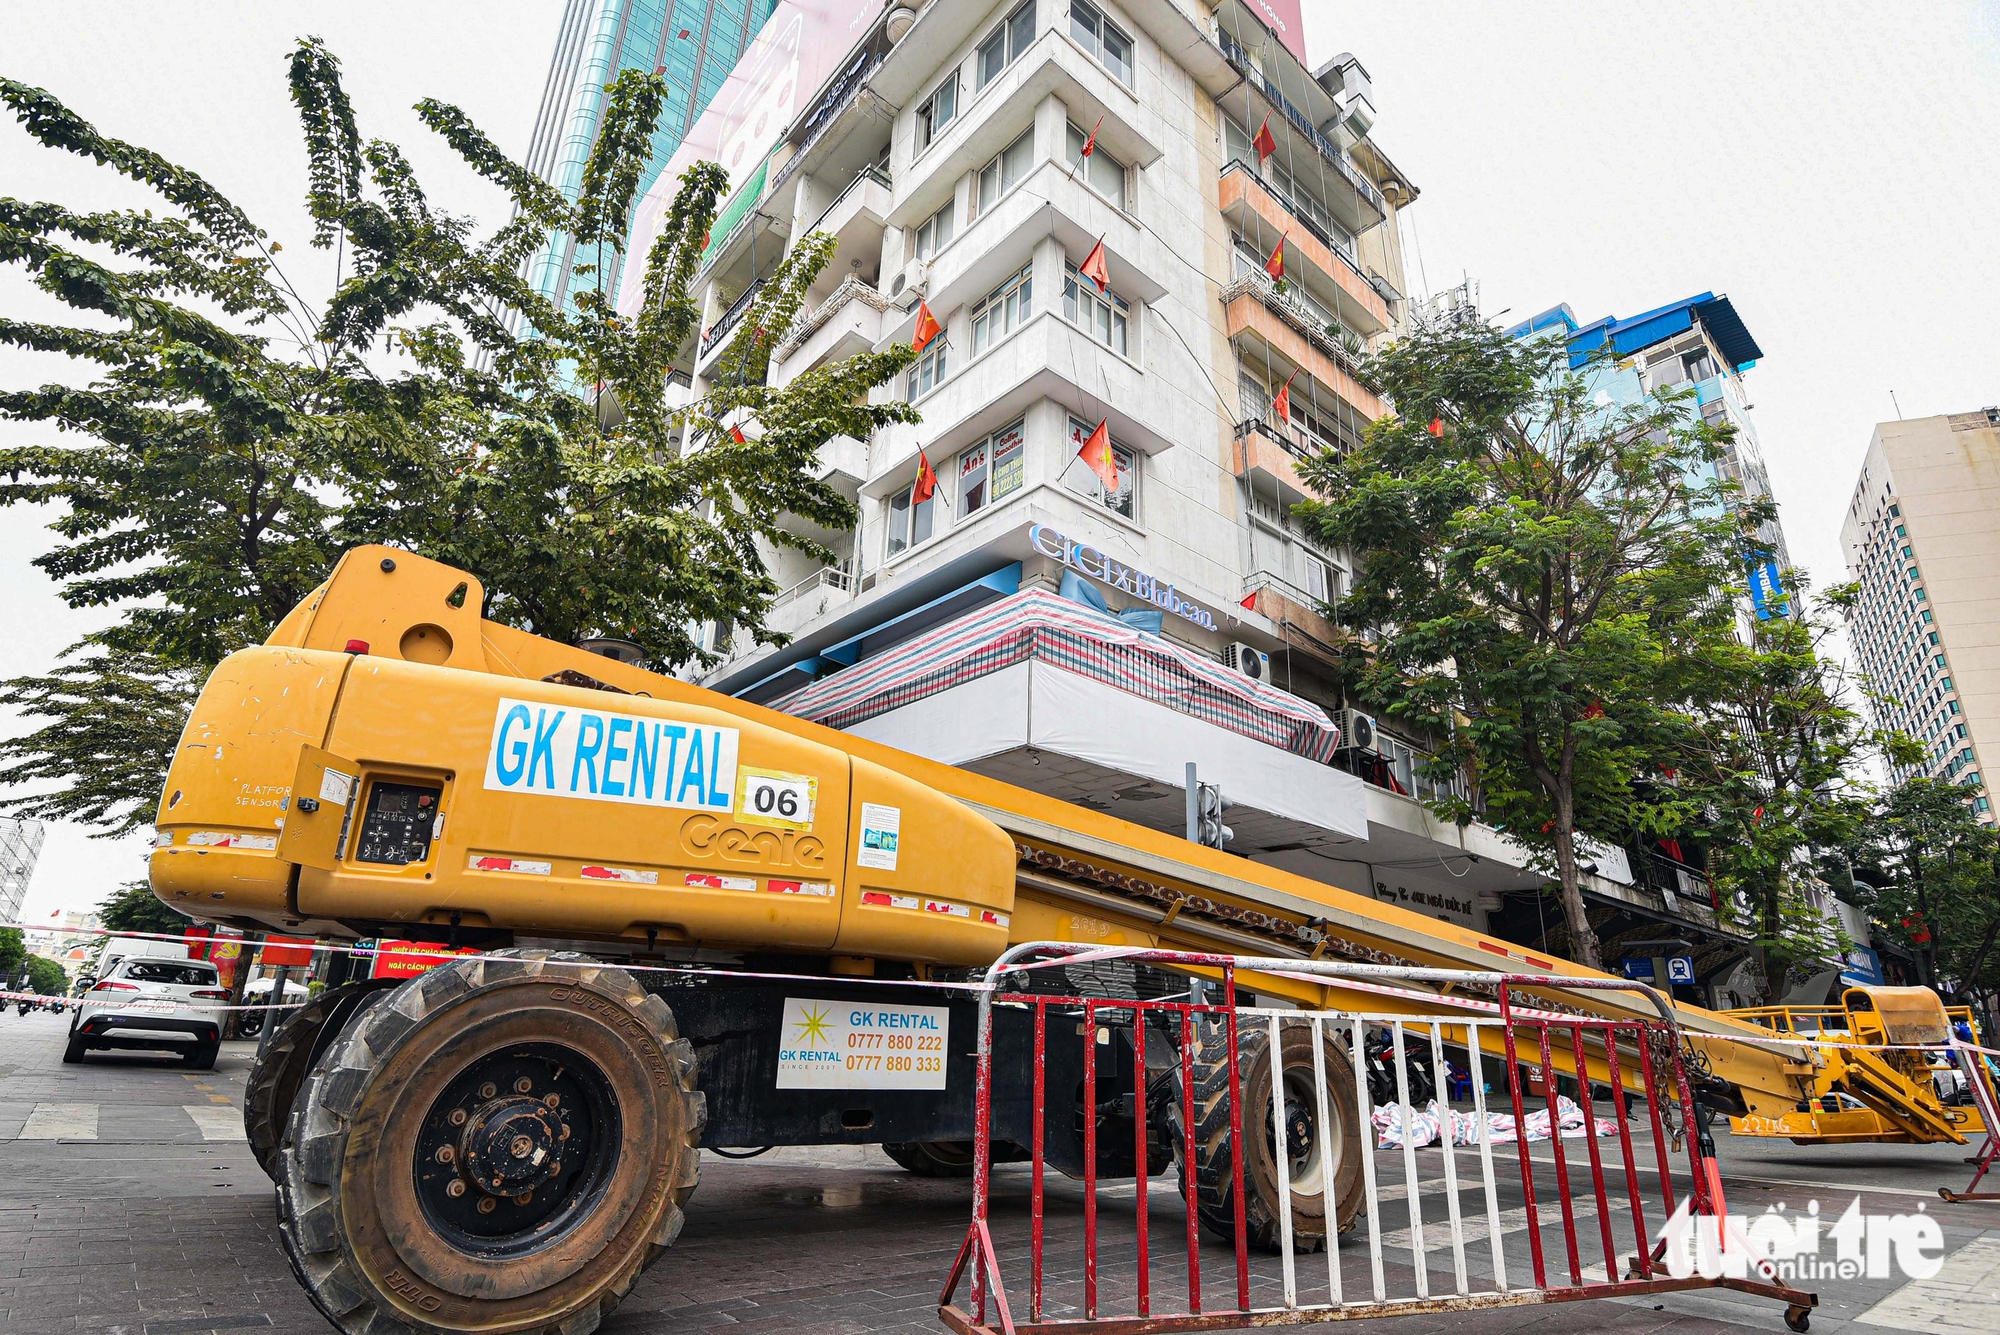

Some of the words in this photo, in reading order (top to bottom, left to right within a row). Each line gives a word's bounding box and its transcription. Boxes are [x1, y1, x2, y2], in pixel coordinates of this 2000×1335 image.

[496, 704, 566, 790] GK
[570, 714, 729, 808] RENTAL
[235, 796, 279, 809] SENSOR
[754, 785, 799, 817] 06
[679, 813, 825, 869] Genie
[850, 1011, 874, 1027] GK
[878, 1013, 939, 1030] RENTAL
[550, 987, 669, 1088] OUTRIGGER
[847, 1033, 884, 1049] 0777
[887, 1034, 913, 1050] 880
[917, 1035, 942, 1051] 222
[779, 1050, 797, 1061] GK
[800, 1051, 842, 1062] RENTAL
[846, 1055, 882, 1071] 0777
[886, 1056, 912, 1072] 880
[916, 1057, 941, 1072] 333
[384, 1269, 441, 1311] OTR
